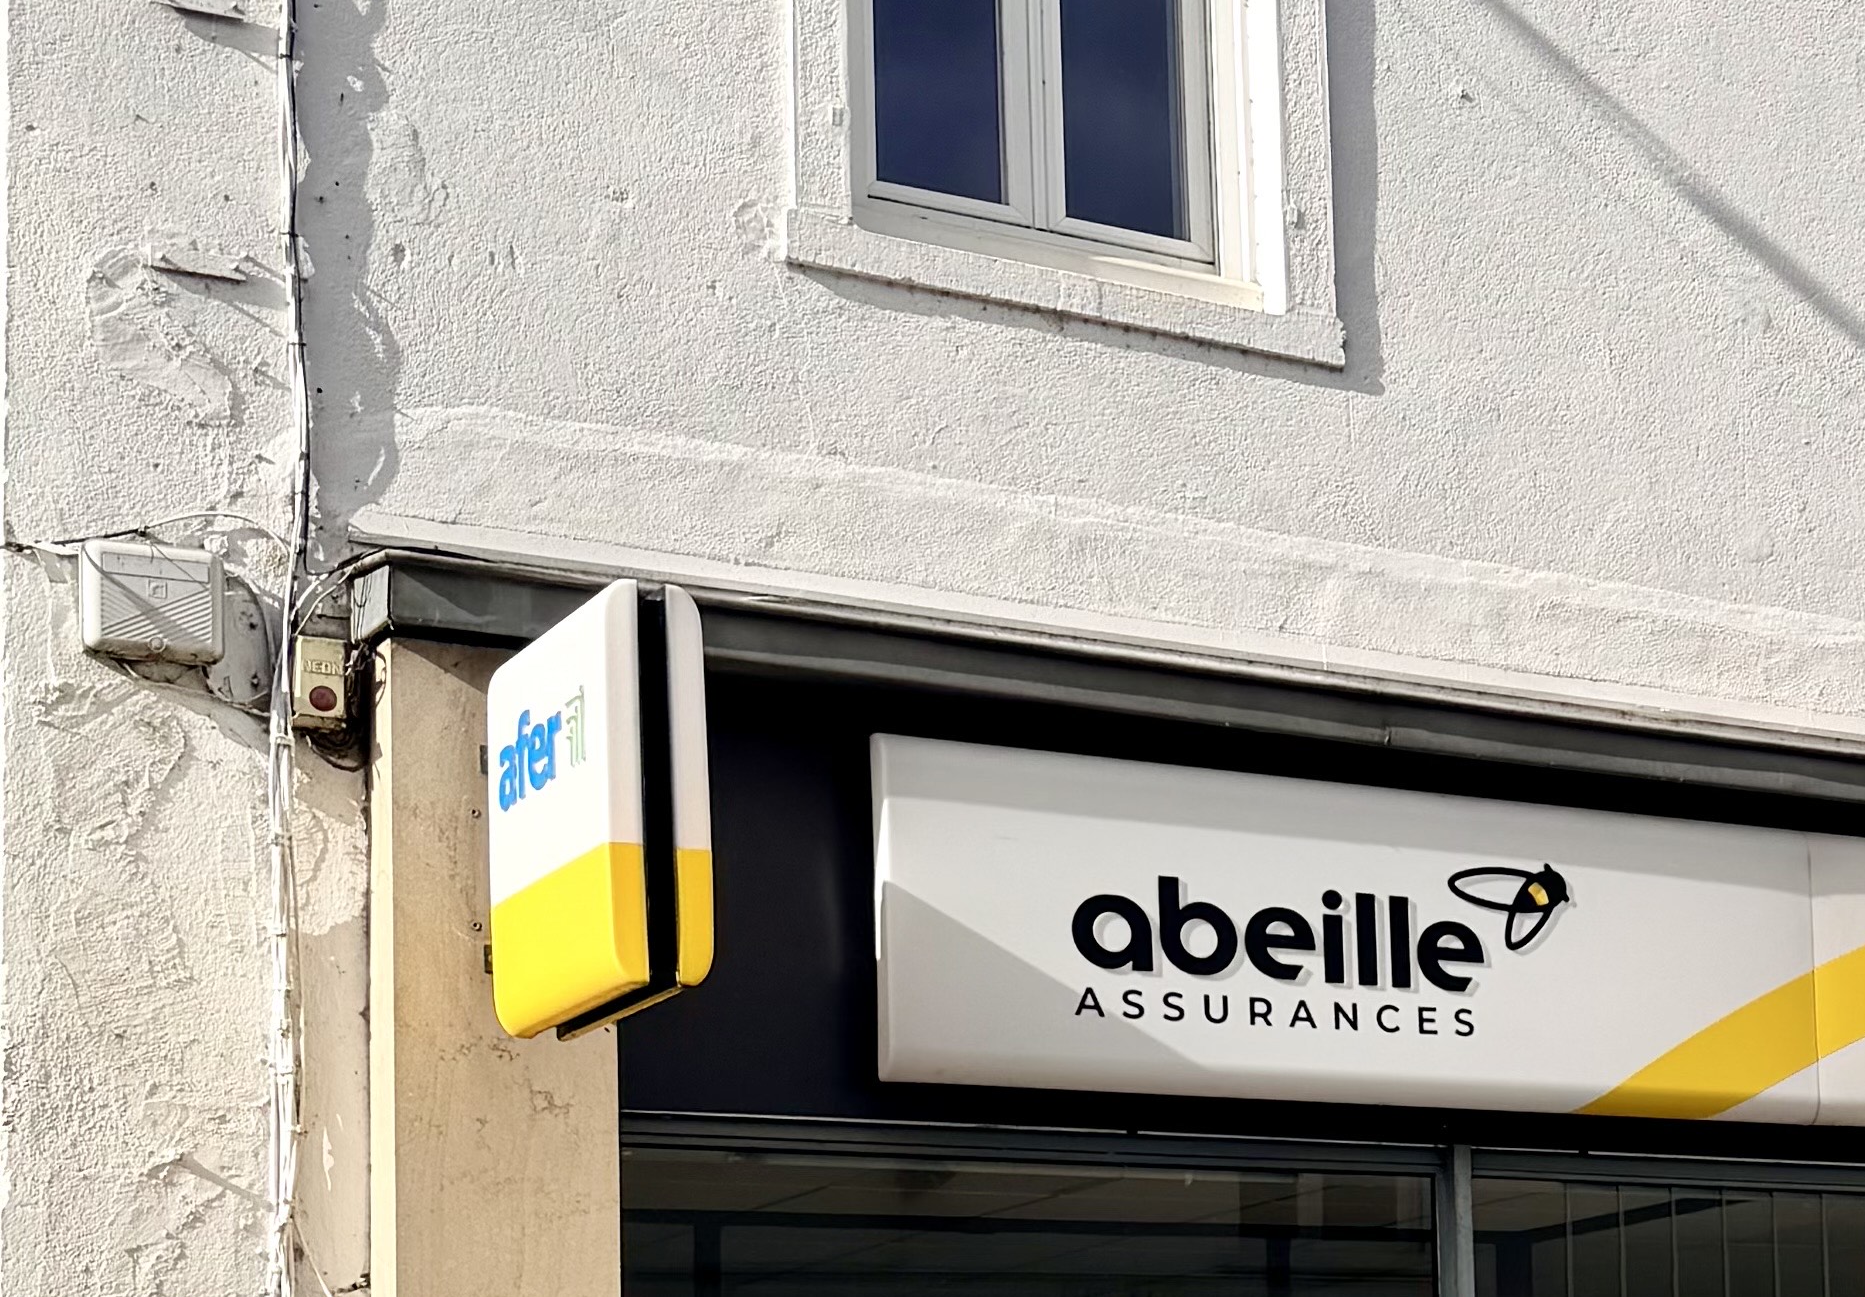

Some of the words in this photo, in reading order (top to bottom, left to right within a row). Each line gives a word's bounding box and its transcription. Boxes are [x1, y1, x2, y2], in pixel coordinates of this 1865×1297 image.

[301, 659, 343, 675] NEON
[499, 710, 562, 812] afer
[1071, 875, 1485, 992] abeille
[1075, 986, 1475, 1037] ASSURANCES
